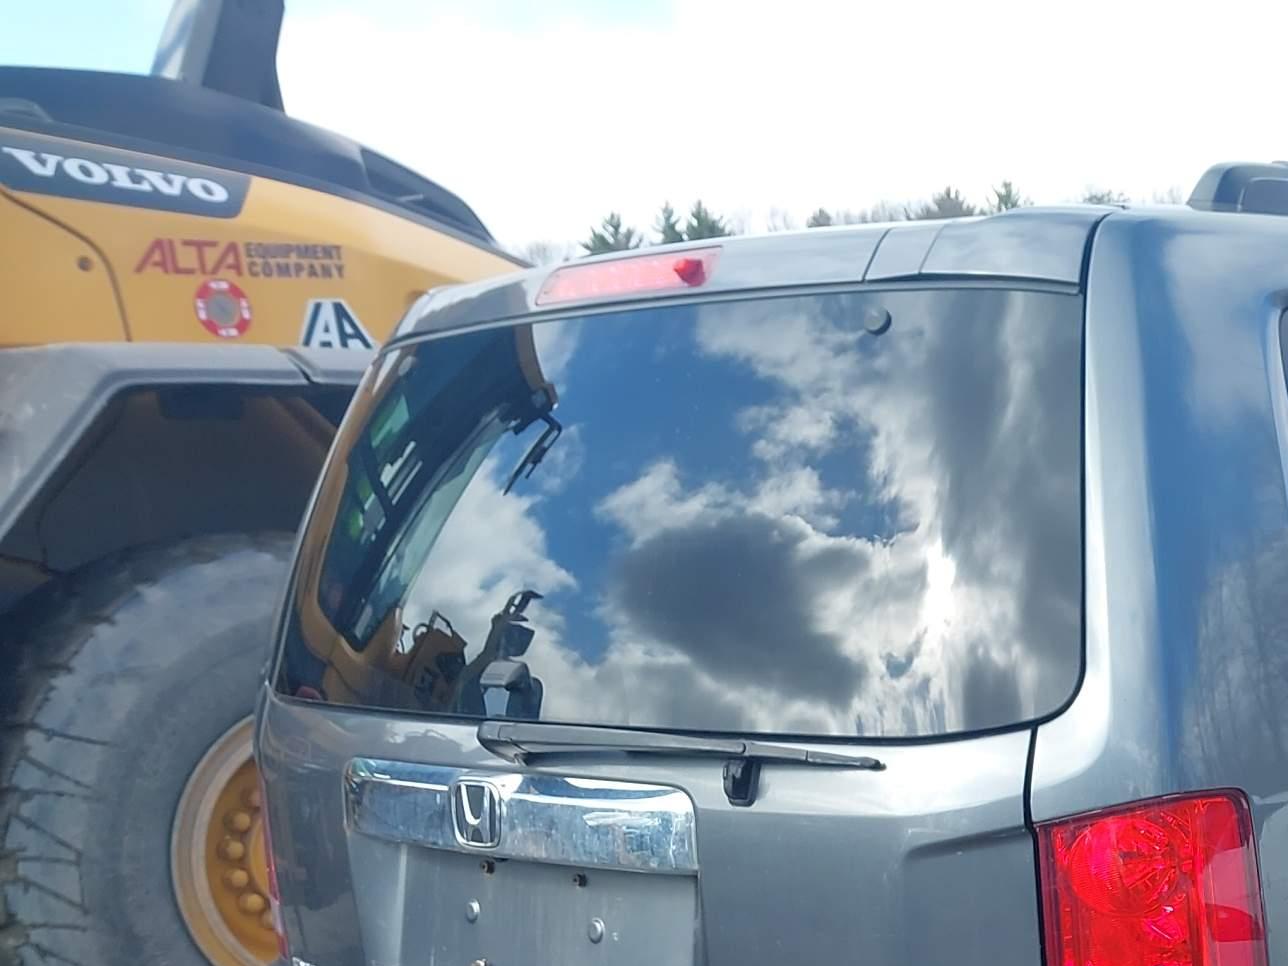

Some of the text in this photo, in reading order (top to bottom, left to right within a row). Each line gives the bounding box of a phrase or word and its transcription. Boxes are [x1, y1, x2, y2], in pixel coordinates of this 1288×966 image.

[1, 146, 229, 203] VOLVO
[133, 238, 244, 277] ALTA
[245, 241, 344, 261] EQUIPMENT
[247, 260, 345, 279] COMPANY
